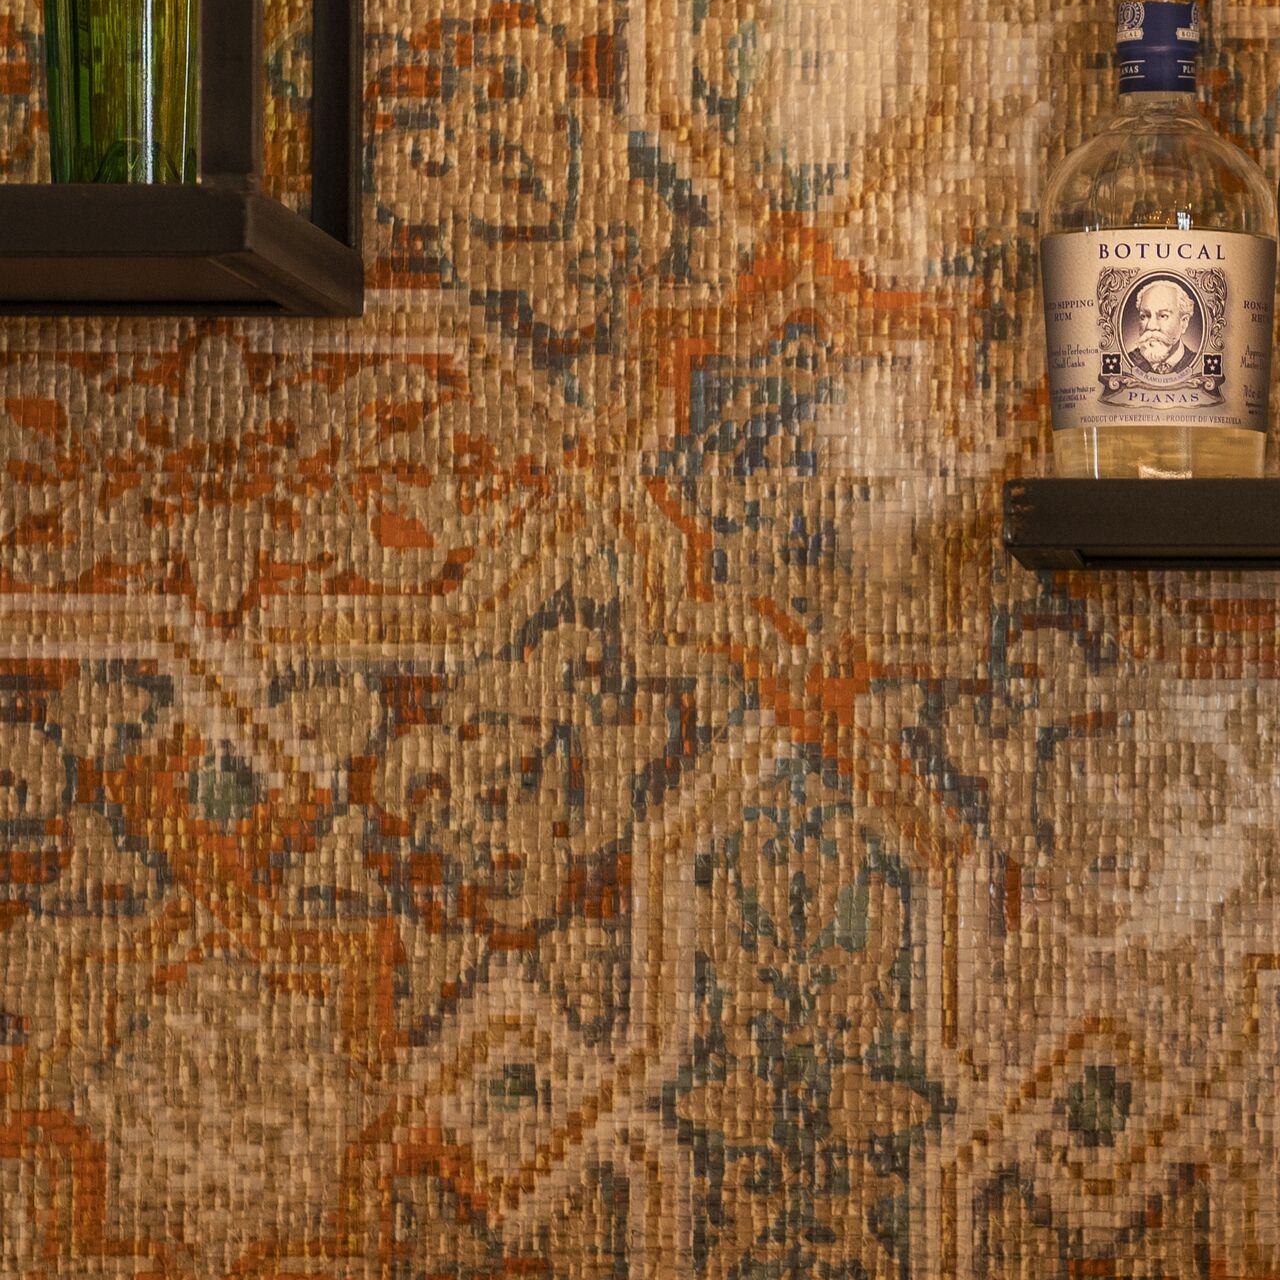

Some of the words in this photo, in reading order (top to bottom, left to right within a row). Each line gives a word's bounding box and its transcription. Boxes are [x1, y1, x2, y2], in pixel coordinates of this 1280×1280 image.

[1098, 242, 1226, 260] BOTUCAL
[1057, 299, 1094, 310] SIPPING
[1053, 311, 1073, 322] RUM
[1067, 344, 1099, 356] Perfection
[1128, 391, 1200, 403] PLANAS
[1080, 415, 1108, 424] PRODUCT
[1119, 414, 1161, 422] VENEZUELA
[1165, 414, 1199, 422] PRODUIT
[1199, 415, 1209, 423] DU
[1209, 416, 1242, 425] VENEZUELA
